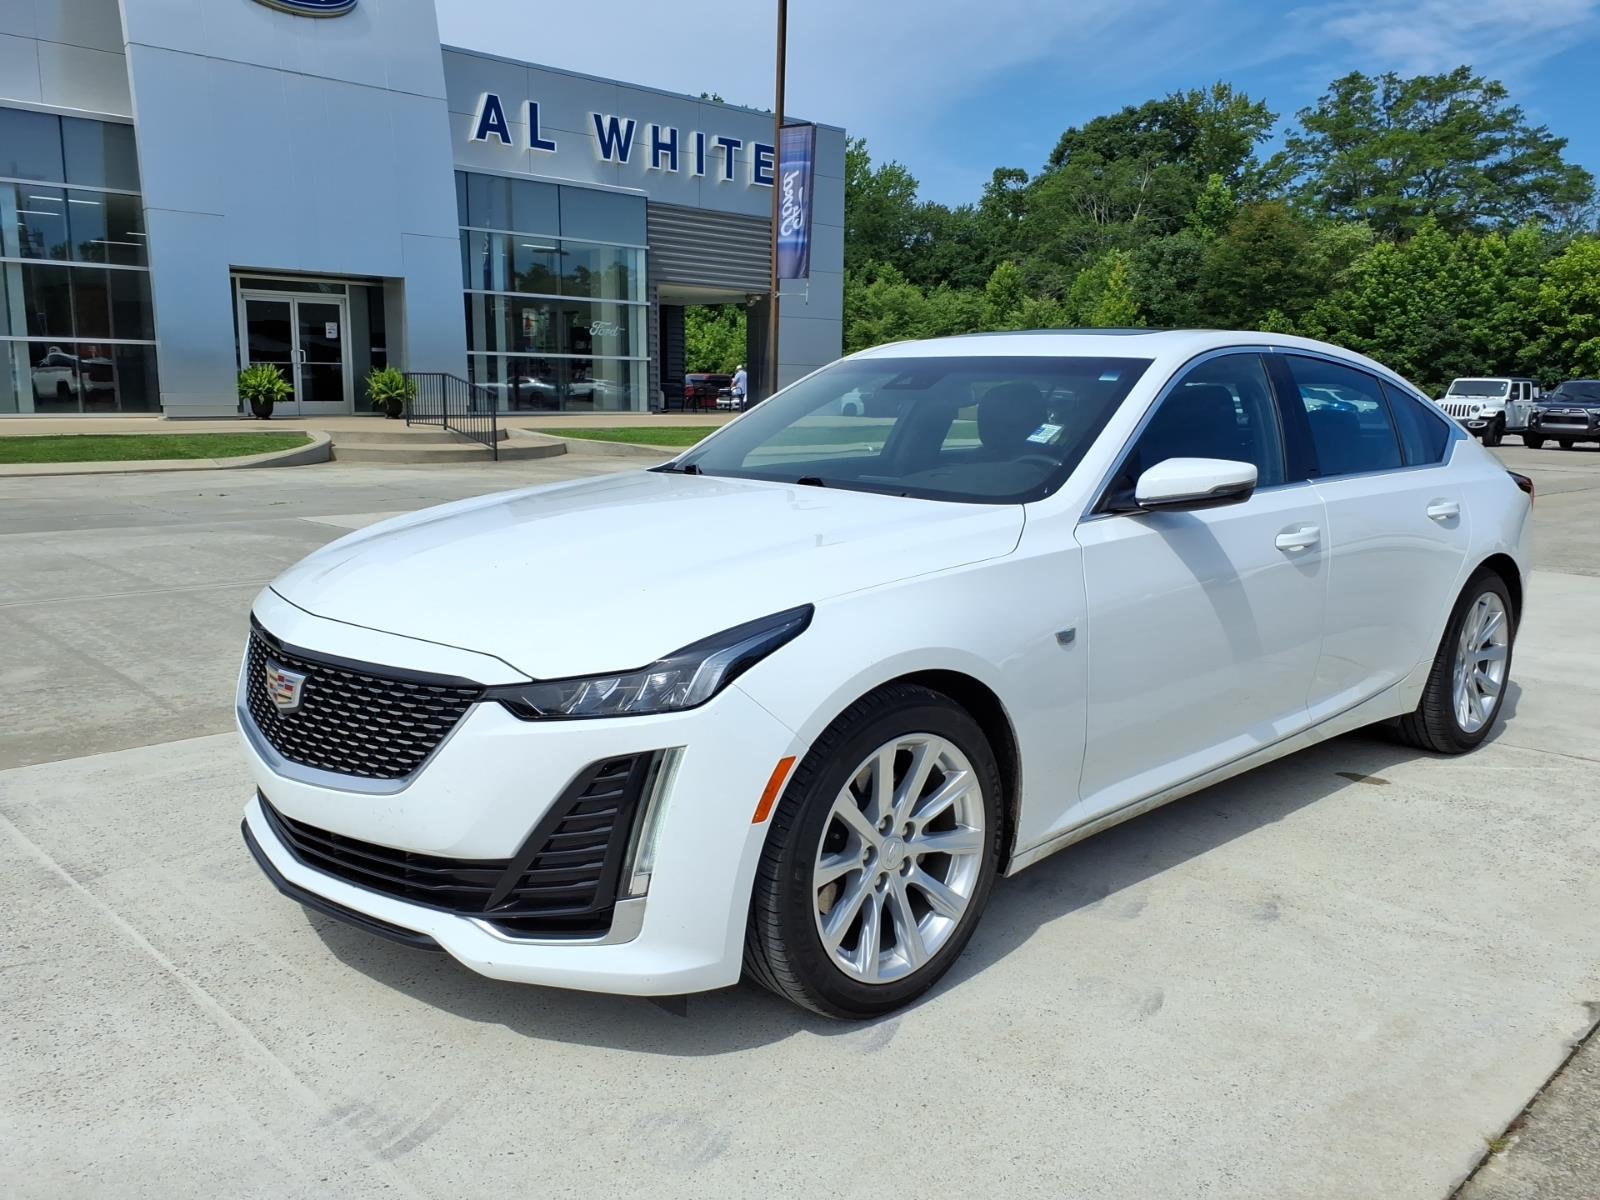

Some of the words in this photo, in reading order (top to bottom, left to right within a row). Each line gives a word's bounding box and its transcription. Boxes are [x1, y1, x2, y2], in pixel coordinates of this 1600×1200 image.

[471, 92, 558, 153] AL
[591, 113, 774, 188] WHITE
[589, 320, 619, 337] Ford
